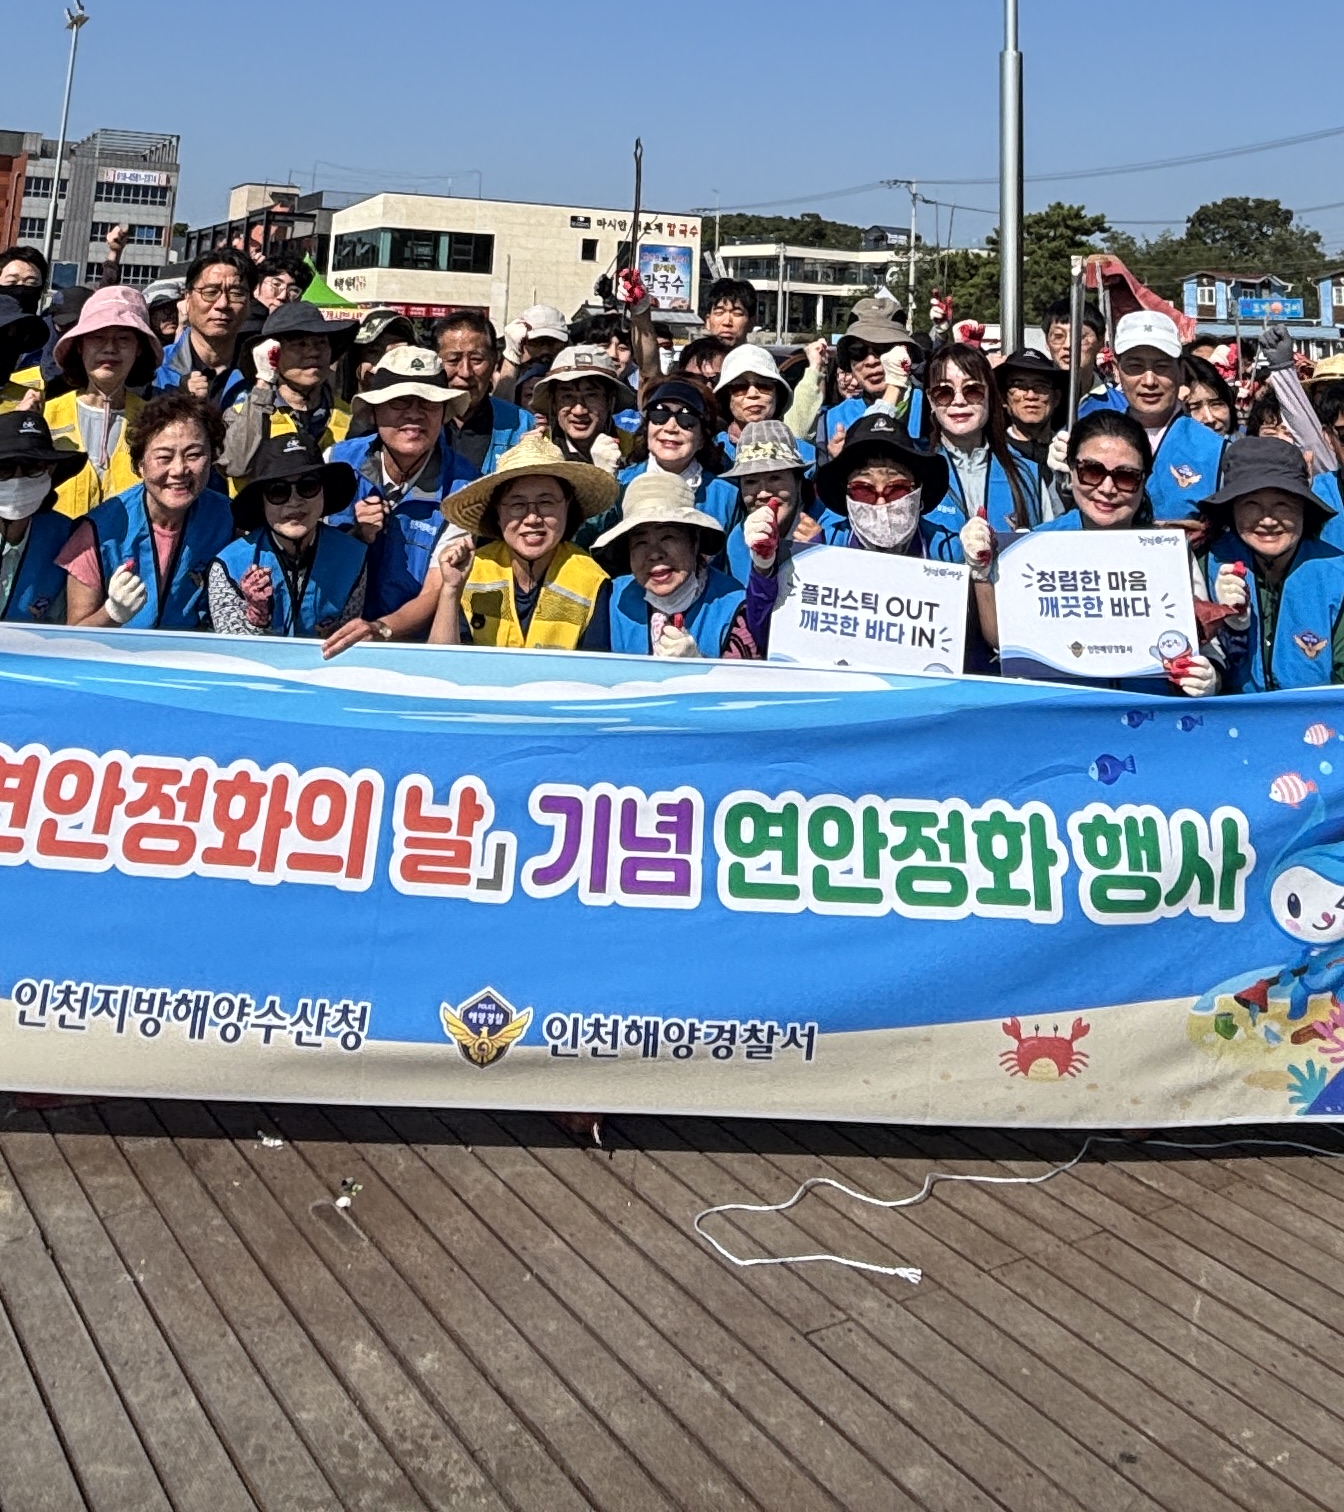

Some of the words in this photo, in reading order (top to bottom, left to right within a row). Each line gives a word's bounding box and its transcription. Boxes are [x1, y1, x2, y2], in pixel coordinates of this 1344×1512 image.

[597, 218, 627, 231] 마시안
[644, 273, 684, 294] 칼국수
[1037, 570, 1100, 592] 청렴한
[1108, 571, 1147, 592] 마음
[801, 583, 879, 614] 플라스틱
[886, 597, 940, 622] OUT
[1038, 596, 1103, 618] 깨끗한
[1110, 597, 1151, 618] 바다
[799, 610, 859, 637] 깨끗한
[865, 620, 905, 644] 바다
[911, 626, 935, 648] IN
[531, 794, 692, 897] 기념
[724, 801, 1057, 911] 연안정화
[1077, 814, 1248, 913] 행사
[15, 982, 368, 1051] 인천지방해양수산청
[468, 1011, 504, 1025] 해양경찰
[546, 1016, 817, 1061] 인천해양경찰서
